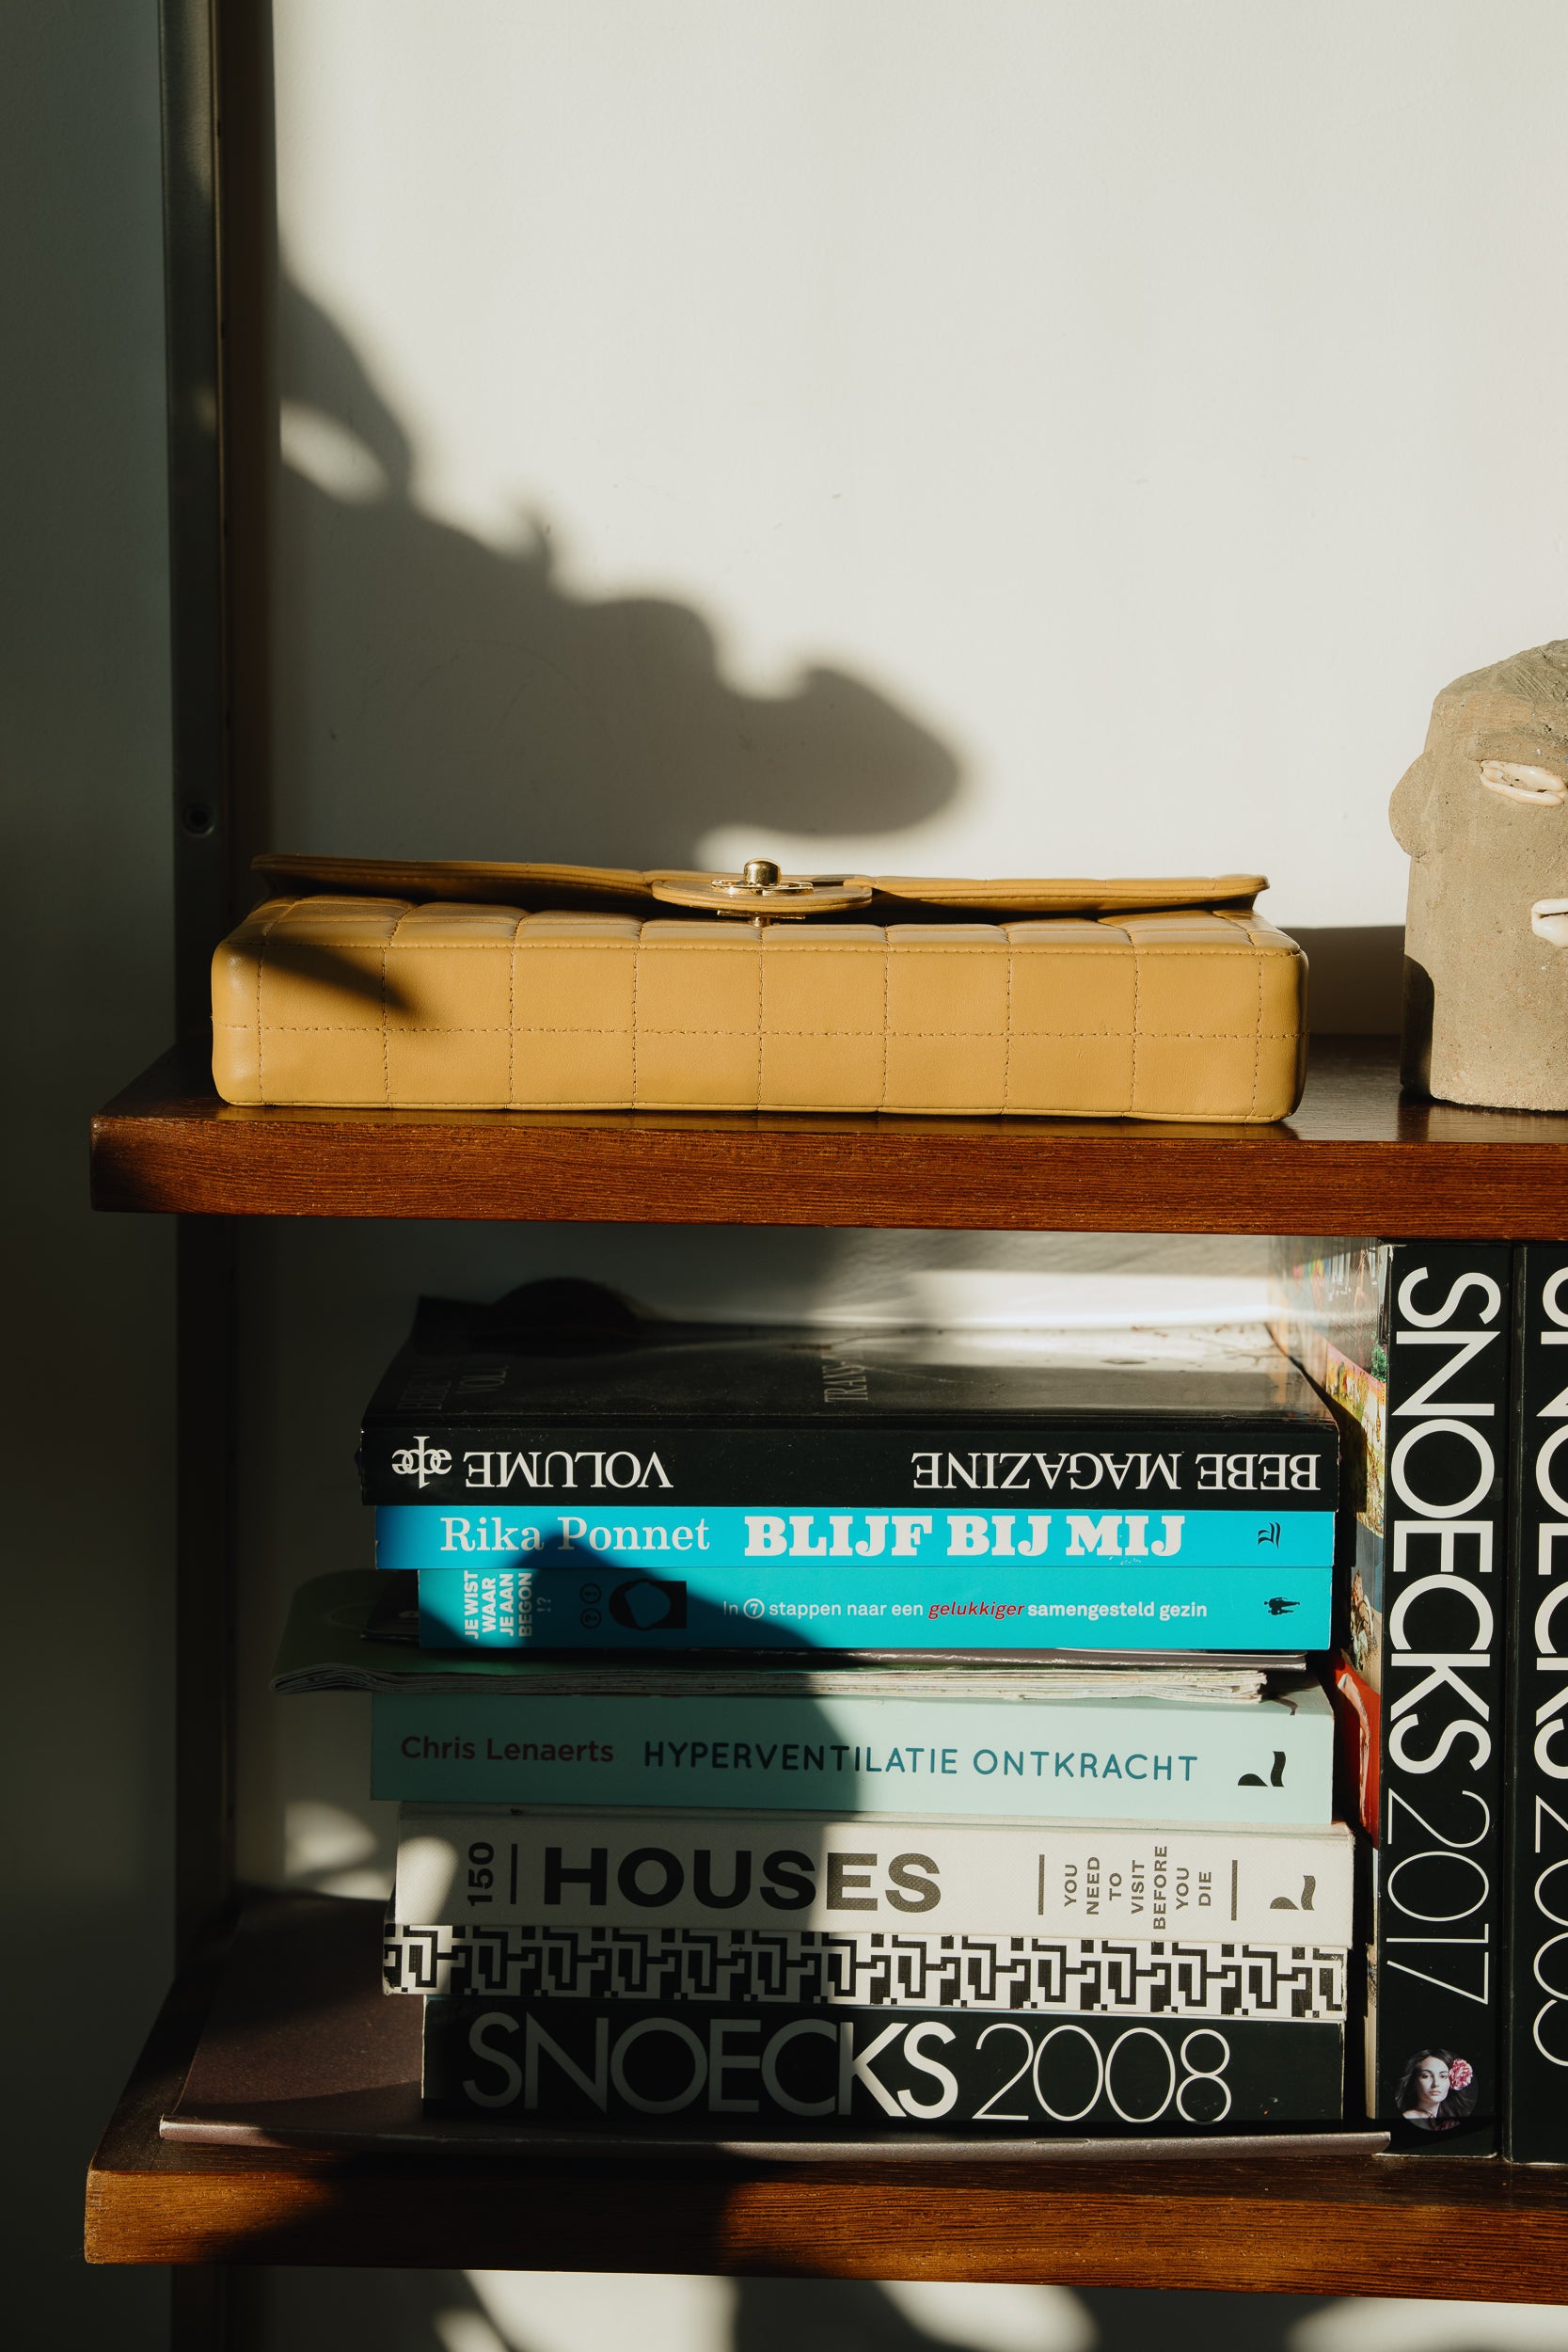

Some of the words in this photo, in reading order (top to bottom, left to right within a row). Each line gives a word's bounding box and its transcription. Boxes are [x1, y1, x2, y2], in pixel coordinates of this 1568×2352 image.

[463, 1451, 673, 1489] VOLUME
[911, 1453, 1182, 1490] MAGAZINE
[1196, 1454, 1322, 1491] BEBE
[440, 1517, 545, 1551] Rika
[558, 1516, 710, 1550] Ponnet
[744, 1515, 933, 1557] BLIJF
[946, 1515, 1052, 1557] BIJ
[1065, 1515, 1185, 1557] MIJ
[1388, 1266, 1501, 1774] SNOECKS
[464, 1569, 479, 1616] WIST
[481, 1577, 497, 1633] WAAR
[499, 1573, 515, 1613] AAN
[517, 1572, 532, 1637] BEGON
[722, 1599, 738, 1615] In
[768, 1600, 842, 1620] stappen
[847, 1603, 888, 1616] naar
[892, 1603, 924, 1616] een
[927, 1600, 1025, 1621] gelukkiger
[1027, 1600, 1155, 1621] samengesteld
[1159, 1600, 1209, 1621] gezin
[464, 1618, 480, 1640] JE
[499, 1616, 515, 1637] JE
[401, 1735, 476, 1760] Chris
[486, 1738, 614, 1763] Lenaerts
[644, 1740, 958, 1775] HYPERVENTILATIE
[972, 1748, 1199, 1782] ONTKRACHT
[467, 1841, 495, 1907] 150
[543, 1846, 942, 1913] HOUSES
[1064, 1864, 1078, 1908] YOU
[1085, 1856, 1101, 1915] NEED
[1108, 1872, 1122, 1901] TO
[1131, 1859, 1145, 1915] VISIT
[1152, 1846, 1167, 1930] BEFORE
[1176, 1867, 1190, 1911] YOU
[1198, 1871, 1212, 1907] DIE
[1386, 1788, 1490, 2005] 2017
[462, 2010, 958, 2120] SNOECKS
[971, 2023, 1232, 2124] 2008
